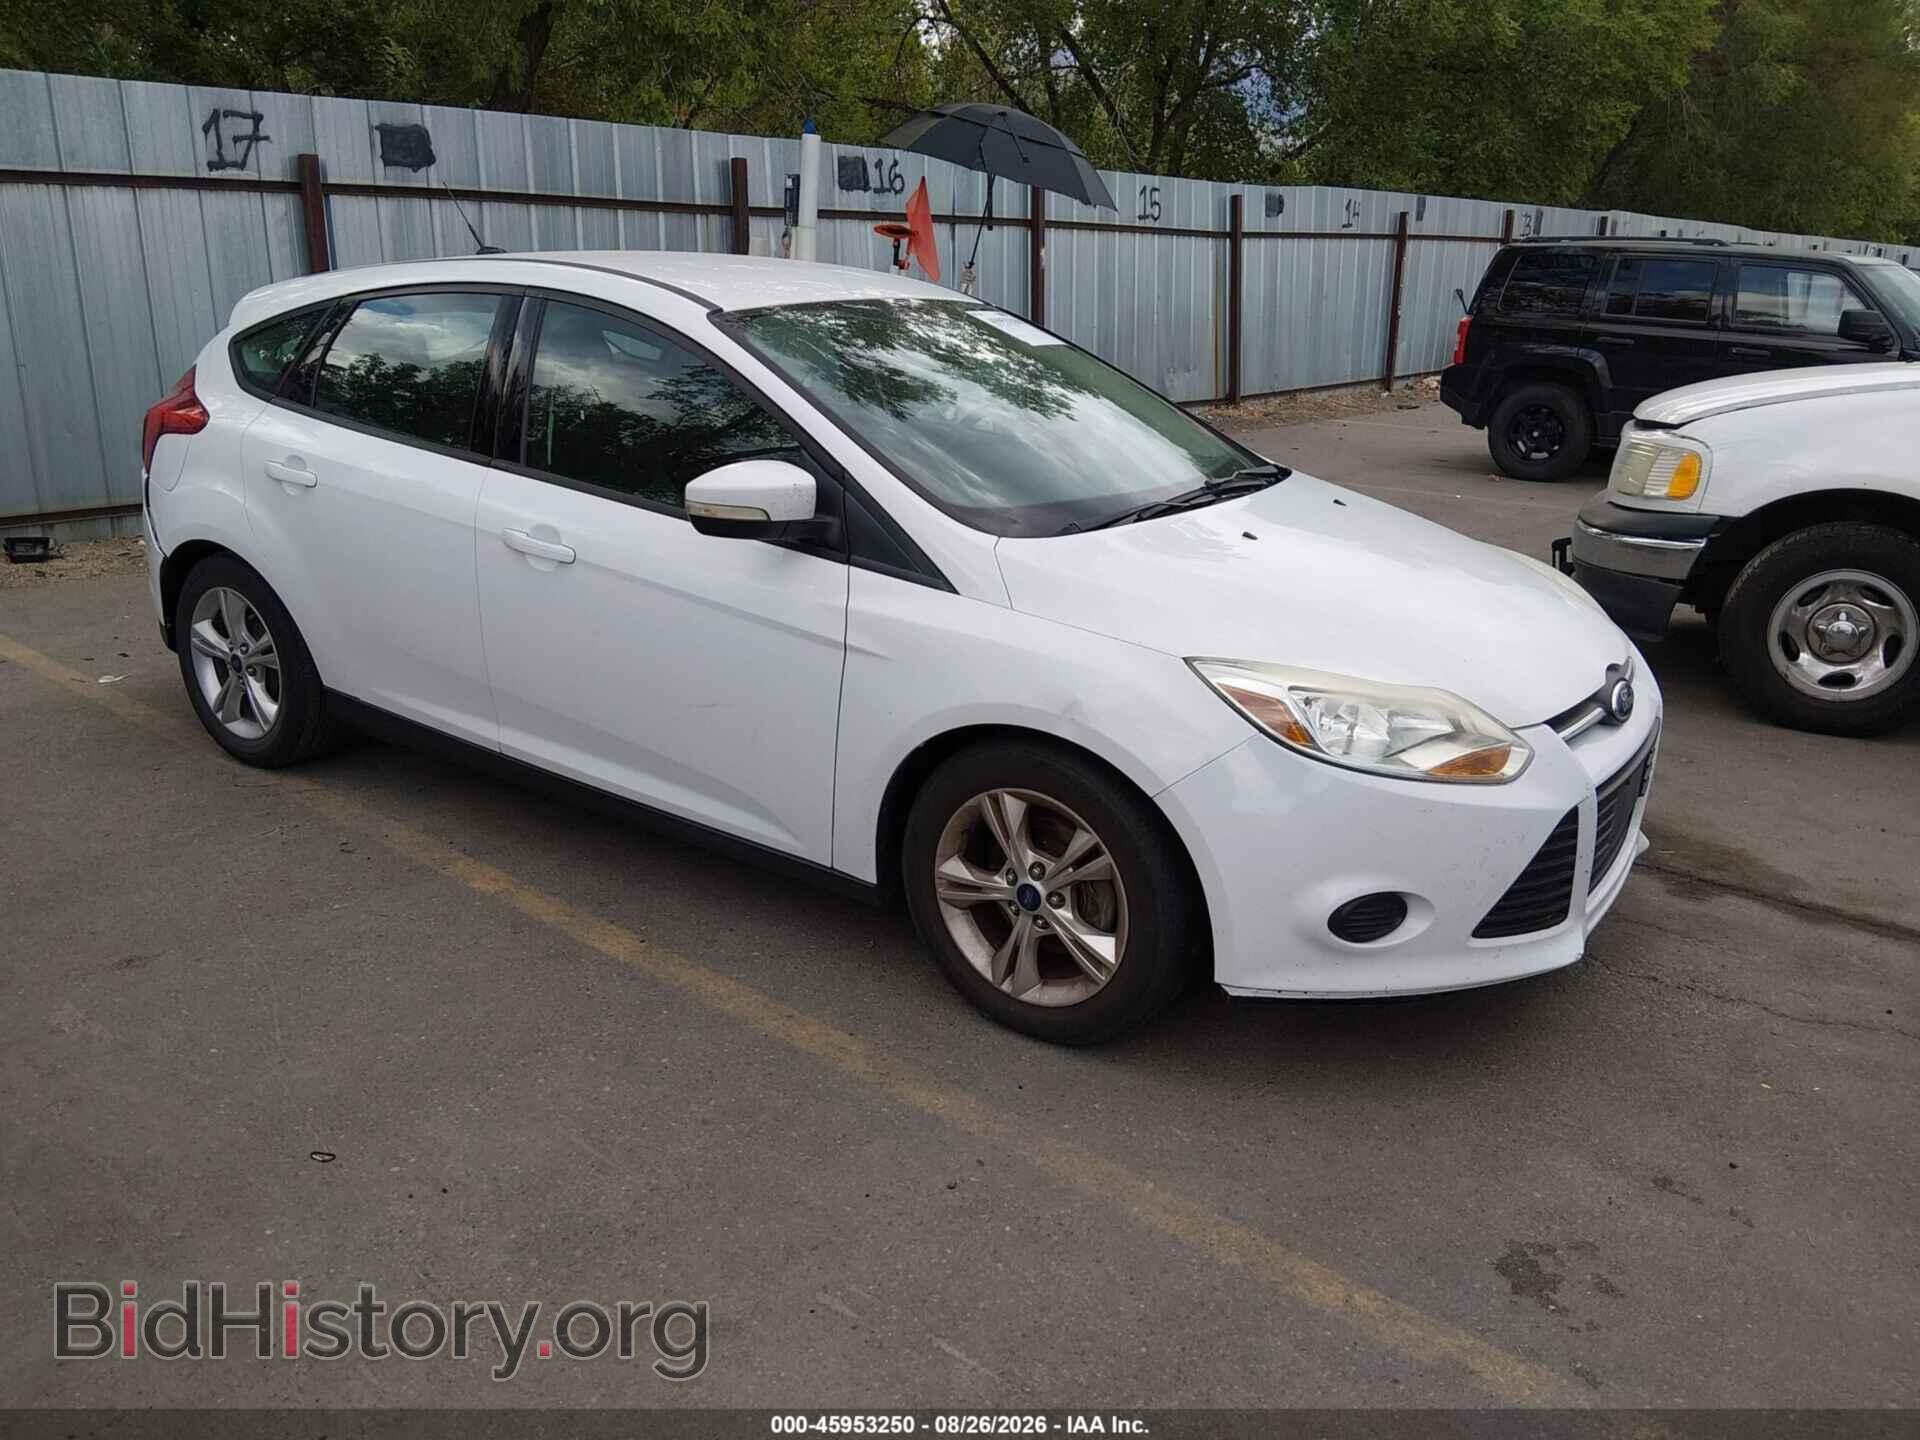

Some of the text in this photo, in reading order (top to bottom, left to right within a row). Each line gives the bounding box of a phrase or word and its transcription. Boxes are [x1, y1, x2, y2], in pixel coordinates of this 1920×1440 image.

[202, 107, 272, 172] 17
[873, 158, 905, 195] 16
[1137, 185, 1161, 221] 15
[1342, 198, 1361, 231] 14
